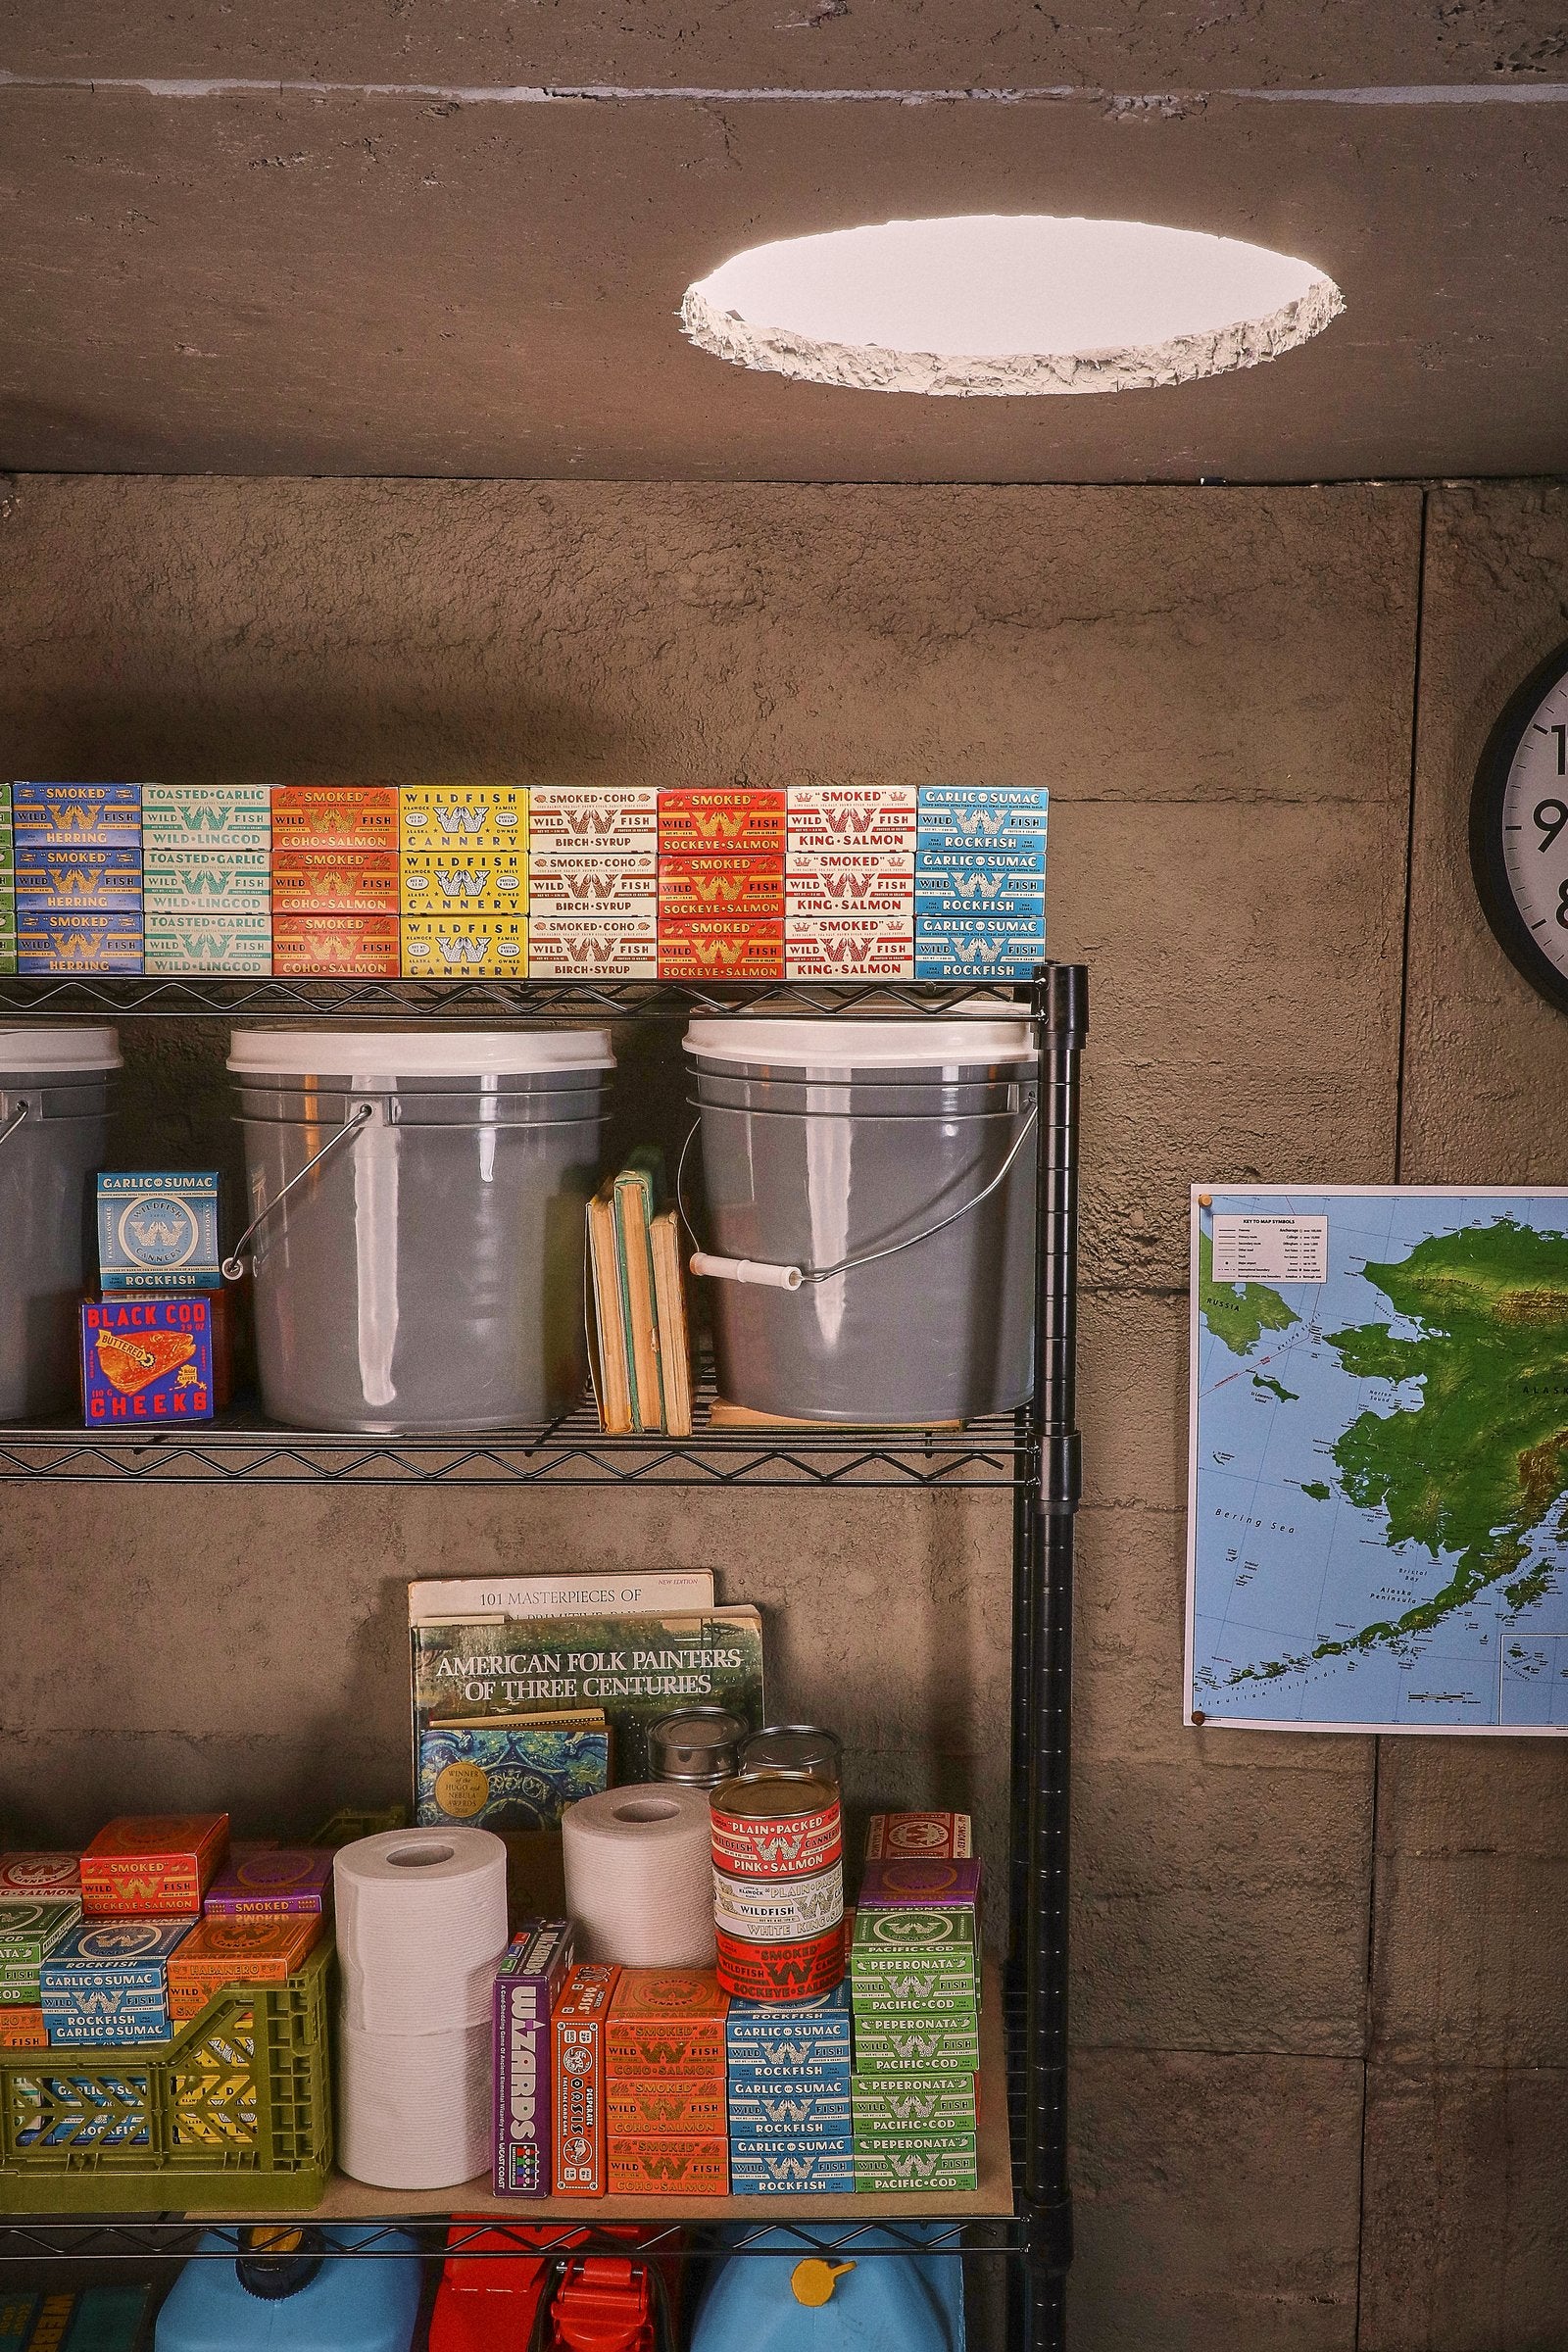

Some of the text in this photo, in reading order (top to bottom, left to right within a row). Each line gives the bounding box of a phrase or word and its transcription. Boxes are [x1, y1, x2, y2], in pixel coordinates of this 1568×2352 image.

[148, 790, 265, 800] TOASTED GARLIC
[405, 794, 515, 803] WILDFISH
[549, 794, 635, 804] SMOKED COHO
[925, 791, 1039, 805] GARLIC SUMAC
[750, 819, 778, 828] FISH
[922, 816, 1040, 827] WILD FISH
[1533, 799, 1568, 854] 9
[46, 833, 107, 844] HERRING
[153, 834, 261, 844] WILD LINGCOD
[281, 836, 387, 847] COHO SALMON
[408, 837, 516, 846] CANNERY
[556, 838, 589, 847] BIRCH
[799, 835, 904, 845] KING SALMON
[945, 836, 1016, 848] ROCKFISH
[663, 840, 779, 850] SOCKEYE SALMON
[103, 1177, 213, 1189] GARLIC SUMAC
[133, 1201, 182, 1219] WILDFISH
[135, 1248, 182, 1262] CANNERY
[125, 1275, 196, 1286] ROCKFISH
[1206, 1298, 1240, 1312] RUSSIA
[87, 1303, 205, 1328] BLACK COD
[101, 1335, 144, 1359] BUTTERED
[1277, 1333, 1299, 1350] Bering
[90, 1392, 207, 1417] CHEEKS
[1215, 1508, 1295, 1534] Bering Sea
[480, 1589, 642, 1606] 101 MASTERPIECES OF
[1380, 1587, 1412, 1596] Alaska
[1370, 1592, 1417, 1604] Peninsula
[436, 1648, 742, 1677] AMERICAN FOLK PAINTERS
[465, 1674, 712, 1701] OF THREE CENTURIES
[1199, 1669, 1336, 1707] Aleutian Islands
[734, 1854, 823, 1872] PINK SALMON
[164, 1883, 191, 1891] FISH
[87, 1900, 192, 1911] SOCKEYE SALMON
[740, 1905, 795, 1916] WILDFISH
[747, 1917, 825, 1936] WHITE KING
[66, 1960, 137, 1969] ROCKFISH
[189, 1964, 260, 1976] HABANERO
[721, 1960, 764, 1978] WILDFISH
[45, 1974, 153, 1986] GARLIC SUMAC
[856, 1981, 967, 1991] WILD FISH
[733, 1982, 791, 1998] SOCKEYE
[44, 1996, 156, 2008] WILD FISH
[872, 1999, 955, 2010] PACIFIC COD
[68, 2015, 135, 2026] ROCKFISH
[734, 2025, 841, 2036] GARLIC SUMAC
[510, 1985, 546, 2140] WIZARDS
[614, 2065, 714, 2076] COHO SALMON
[755, 2066, 822, 2077] ROCKFISH
[570, 2077, 584, 2135] OASIS
